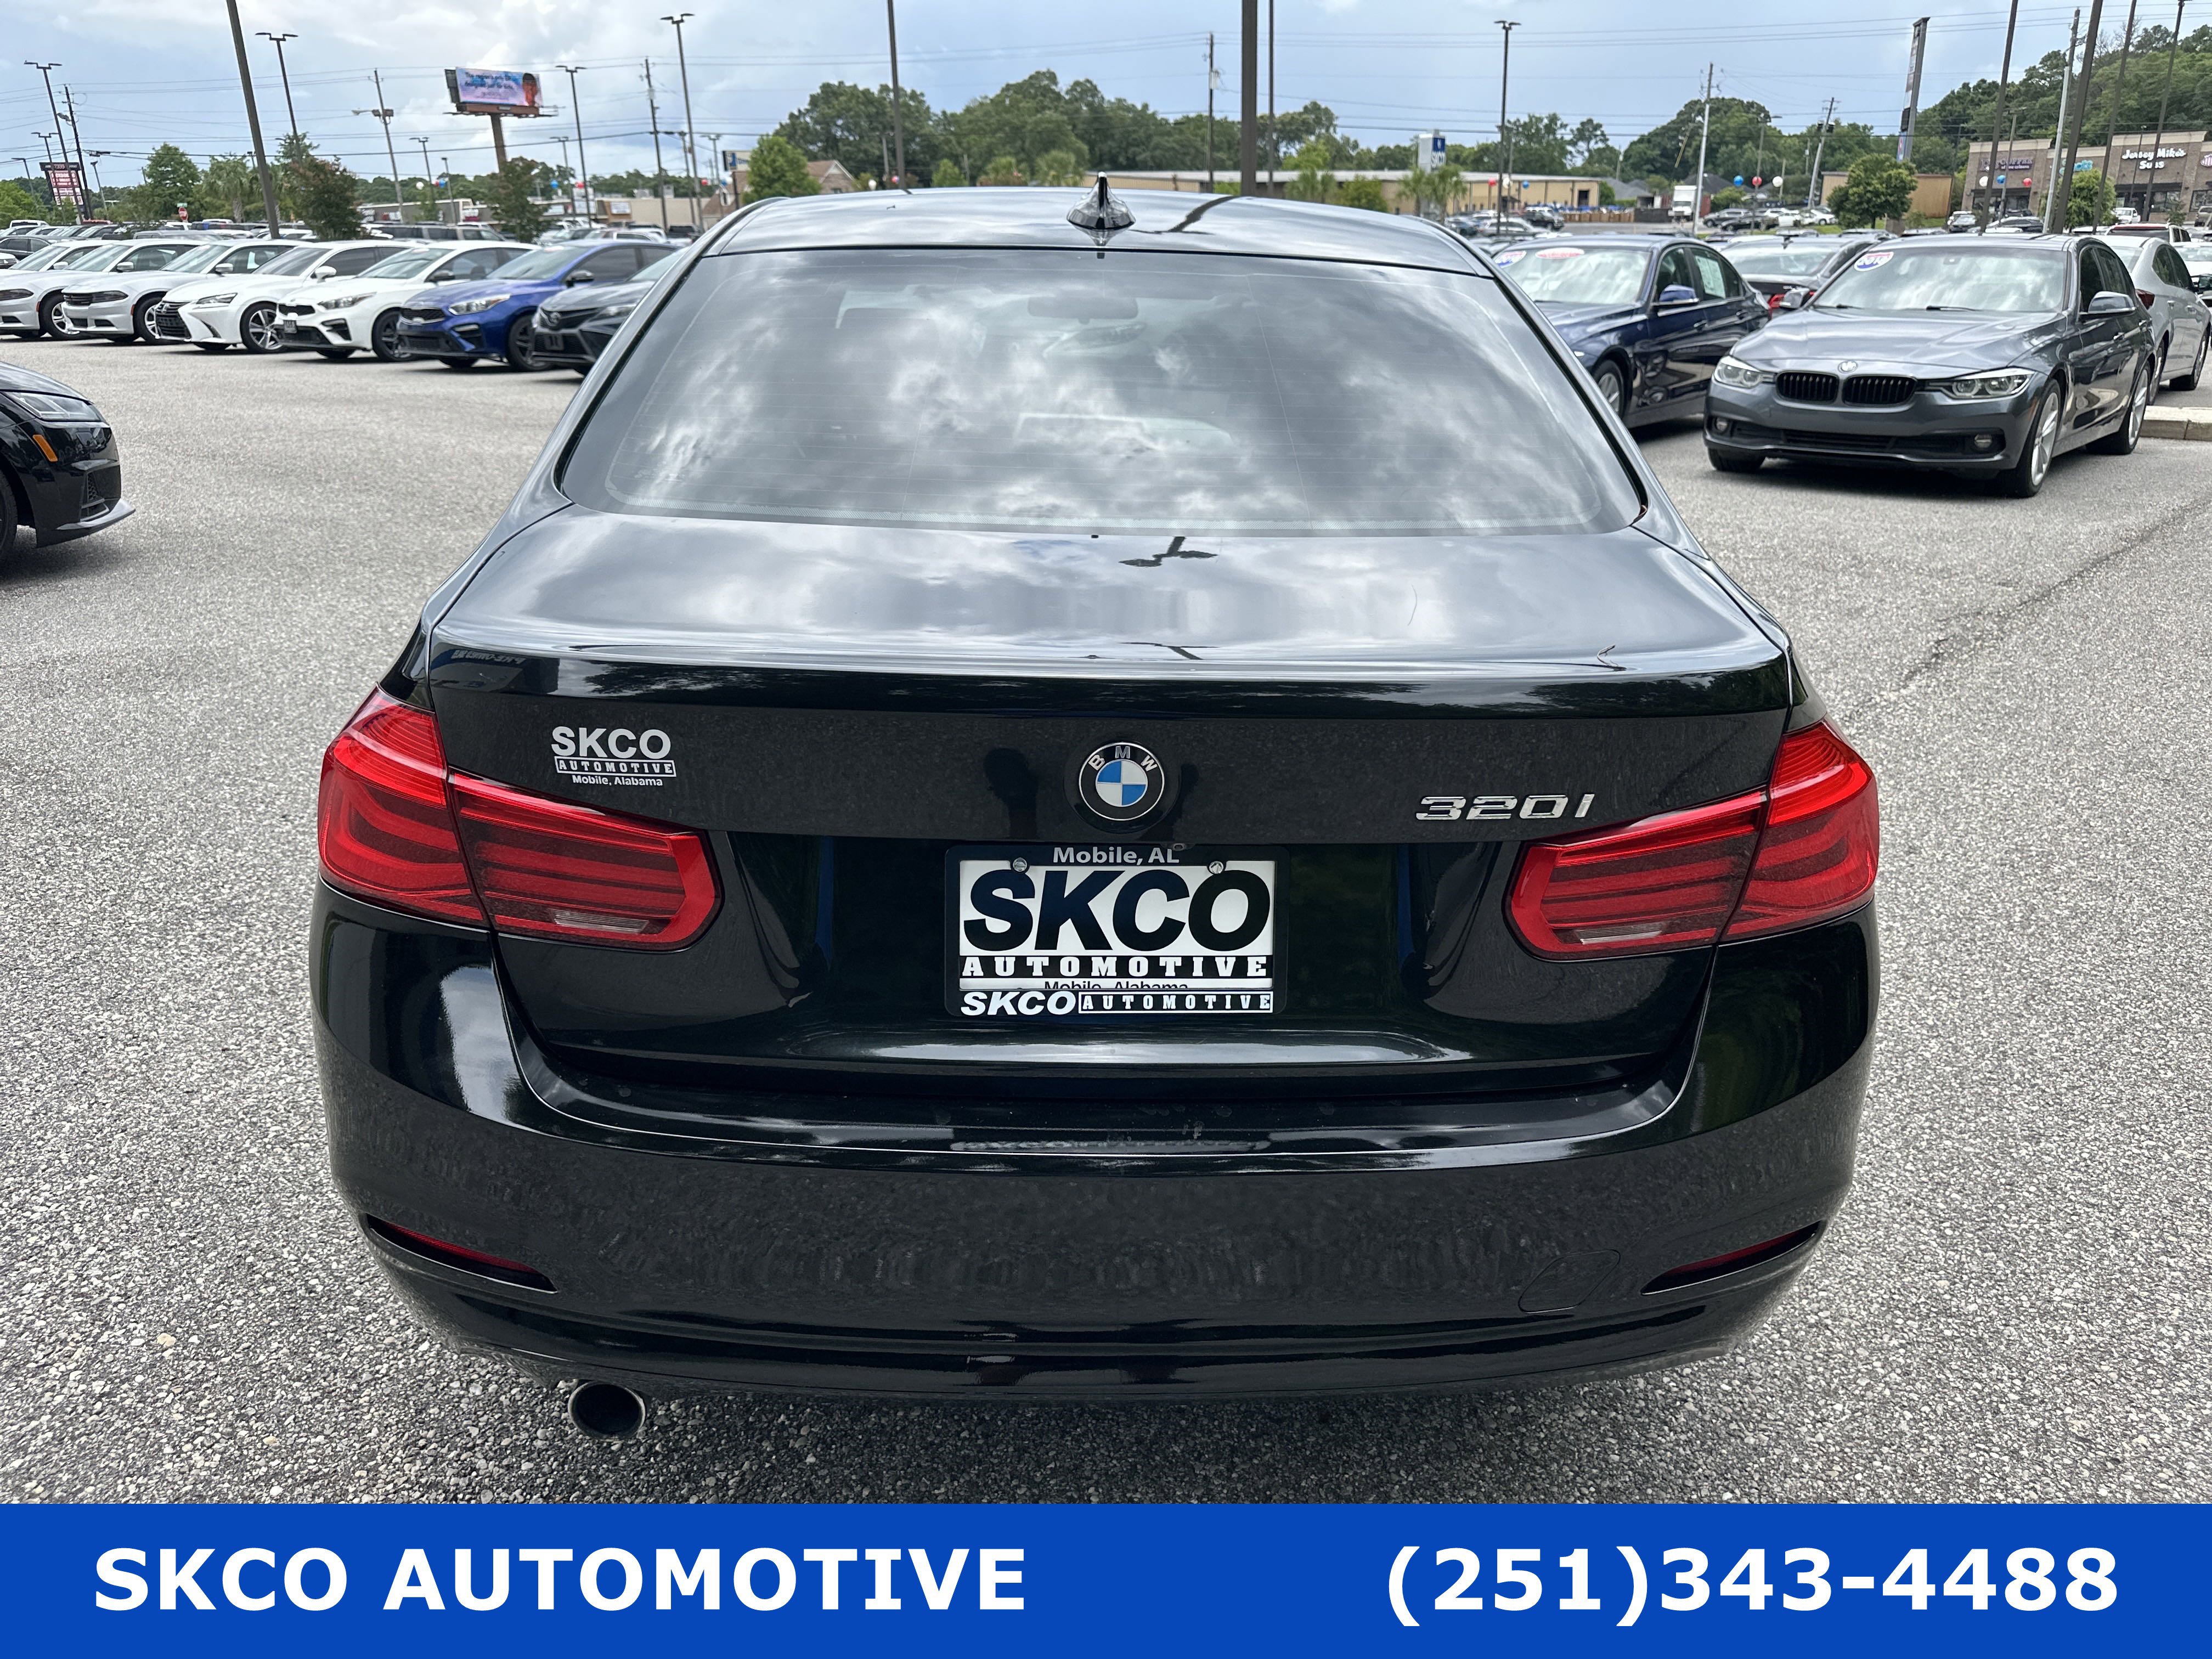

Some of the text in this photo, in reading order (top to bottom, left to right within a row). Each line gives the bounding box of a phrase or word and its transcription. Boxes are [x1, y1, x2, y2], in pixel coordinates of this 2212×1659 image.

[2121, 148, 2186, 161] Jersey Mike's
[551, 726, 671, 759] SKCO
[558, 760, 673, 773] AUTOMOTIVE
[1088, 746, 1158, 772] BMW
[572, 775, 663, 786] Mobile, Alabama
[1053, 847, 1180, 865] Mobile, AL
[963, 869, 1271, 951] SKCO
[962, 956, 1267, 977] AUTOMOTIVE
[960, 991, 1271, 1016] SKCO AUTOMOTIVE
